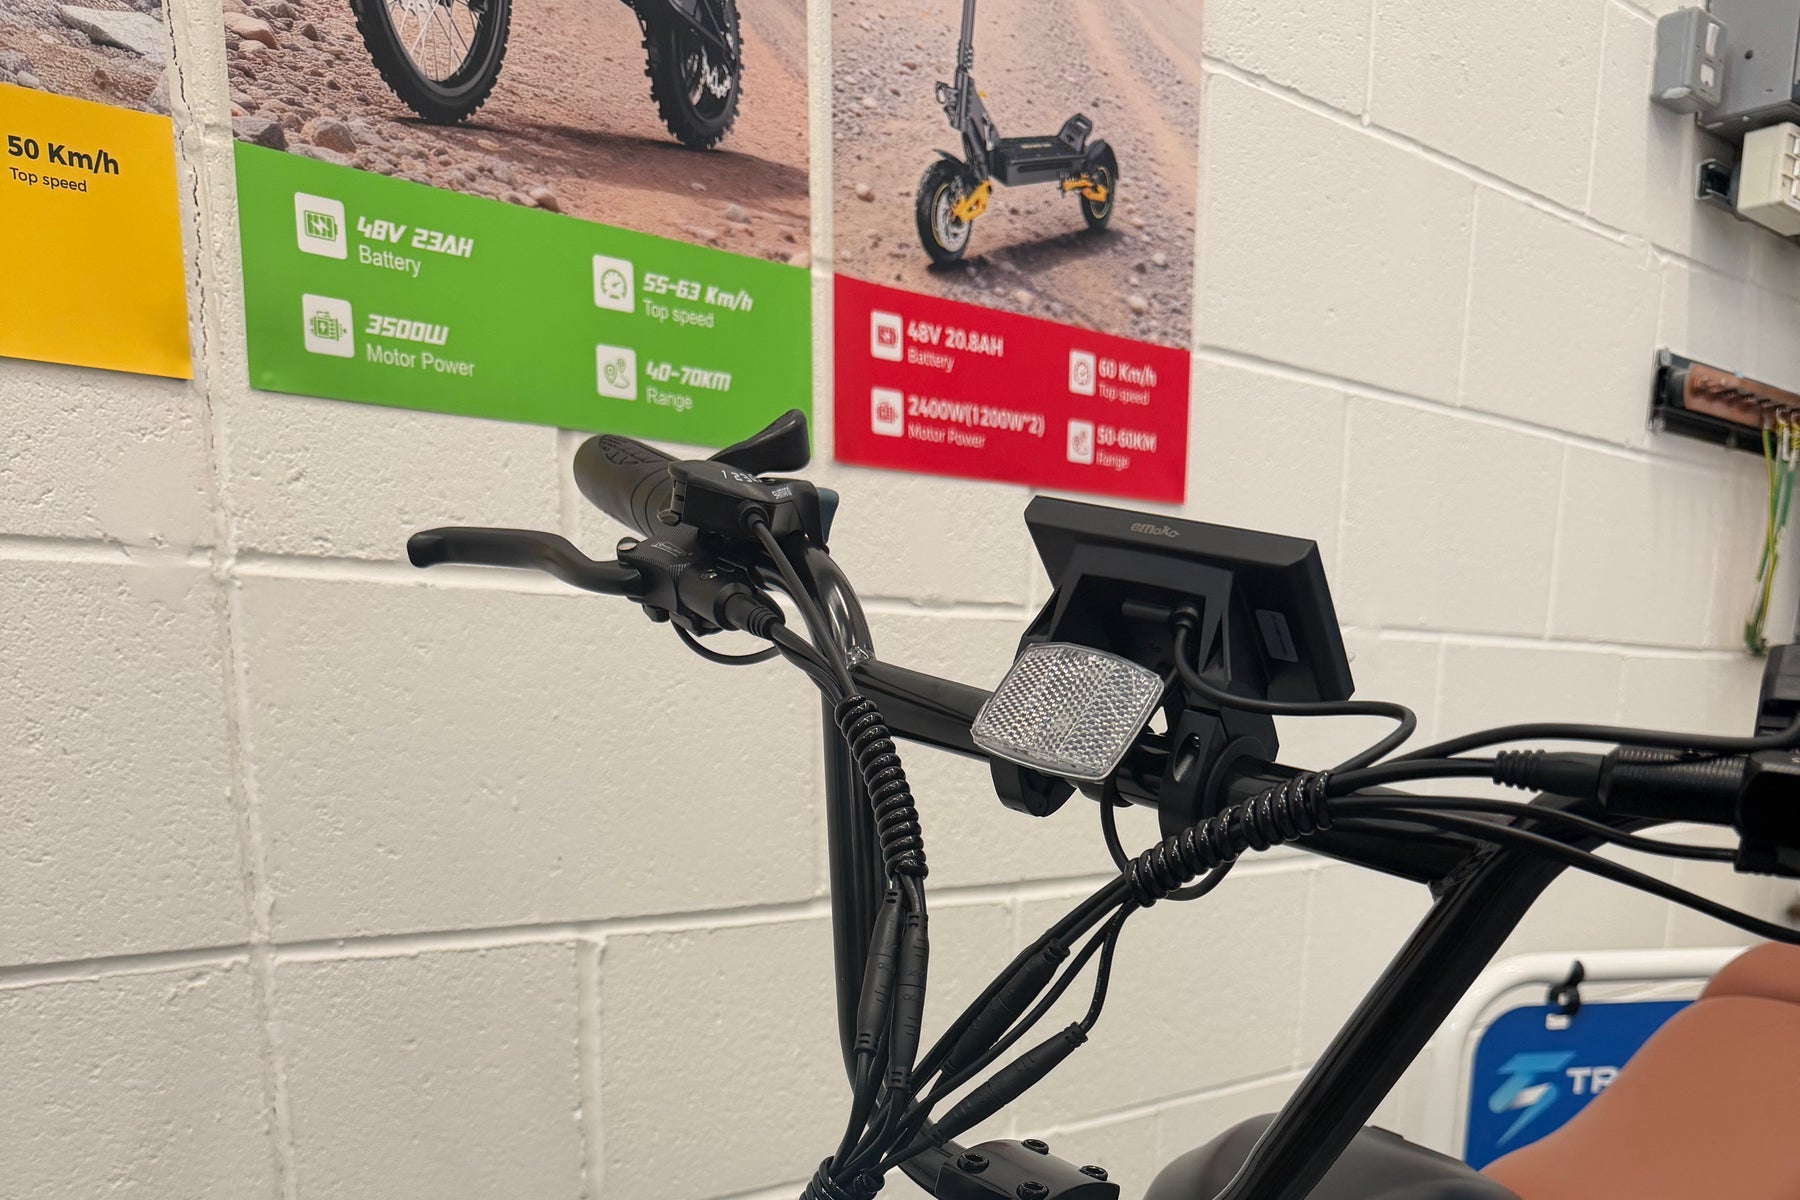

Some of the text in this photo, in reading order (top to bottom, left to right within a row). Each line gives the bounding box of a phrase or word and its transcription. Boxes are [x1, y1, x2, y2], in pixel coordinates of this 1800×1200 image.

[7, 134, 120, 174] 50 Km/h
[9, 166, 87, 192] Top speed
[357, 216, 475, 258] 48V 23AH
[359, 244, 421, 278] Battery
[643, 274, 753, 313] 55-63 Km/h
[643, 299, 714, 330] Top speed
[366, 314, 449, 346] 3500W
[907, 321, 1003, 357] 48V 20.8AH
[367, 343, 475, 378] Motor Power
[908, 346, 954, 373] Battery
[1099, 358, 1157, 388] 60 Km/h
[646, 387, 693, 412] Range
[1099, 383, 1151, 405] Top speed
[908, 422, 986, 449] Motor Power
[1097, 451, 1129, 471] Range
[1566, 1066, 1619, 1094] TR
